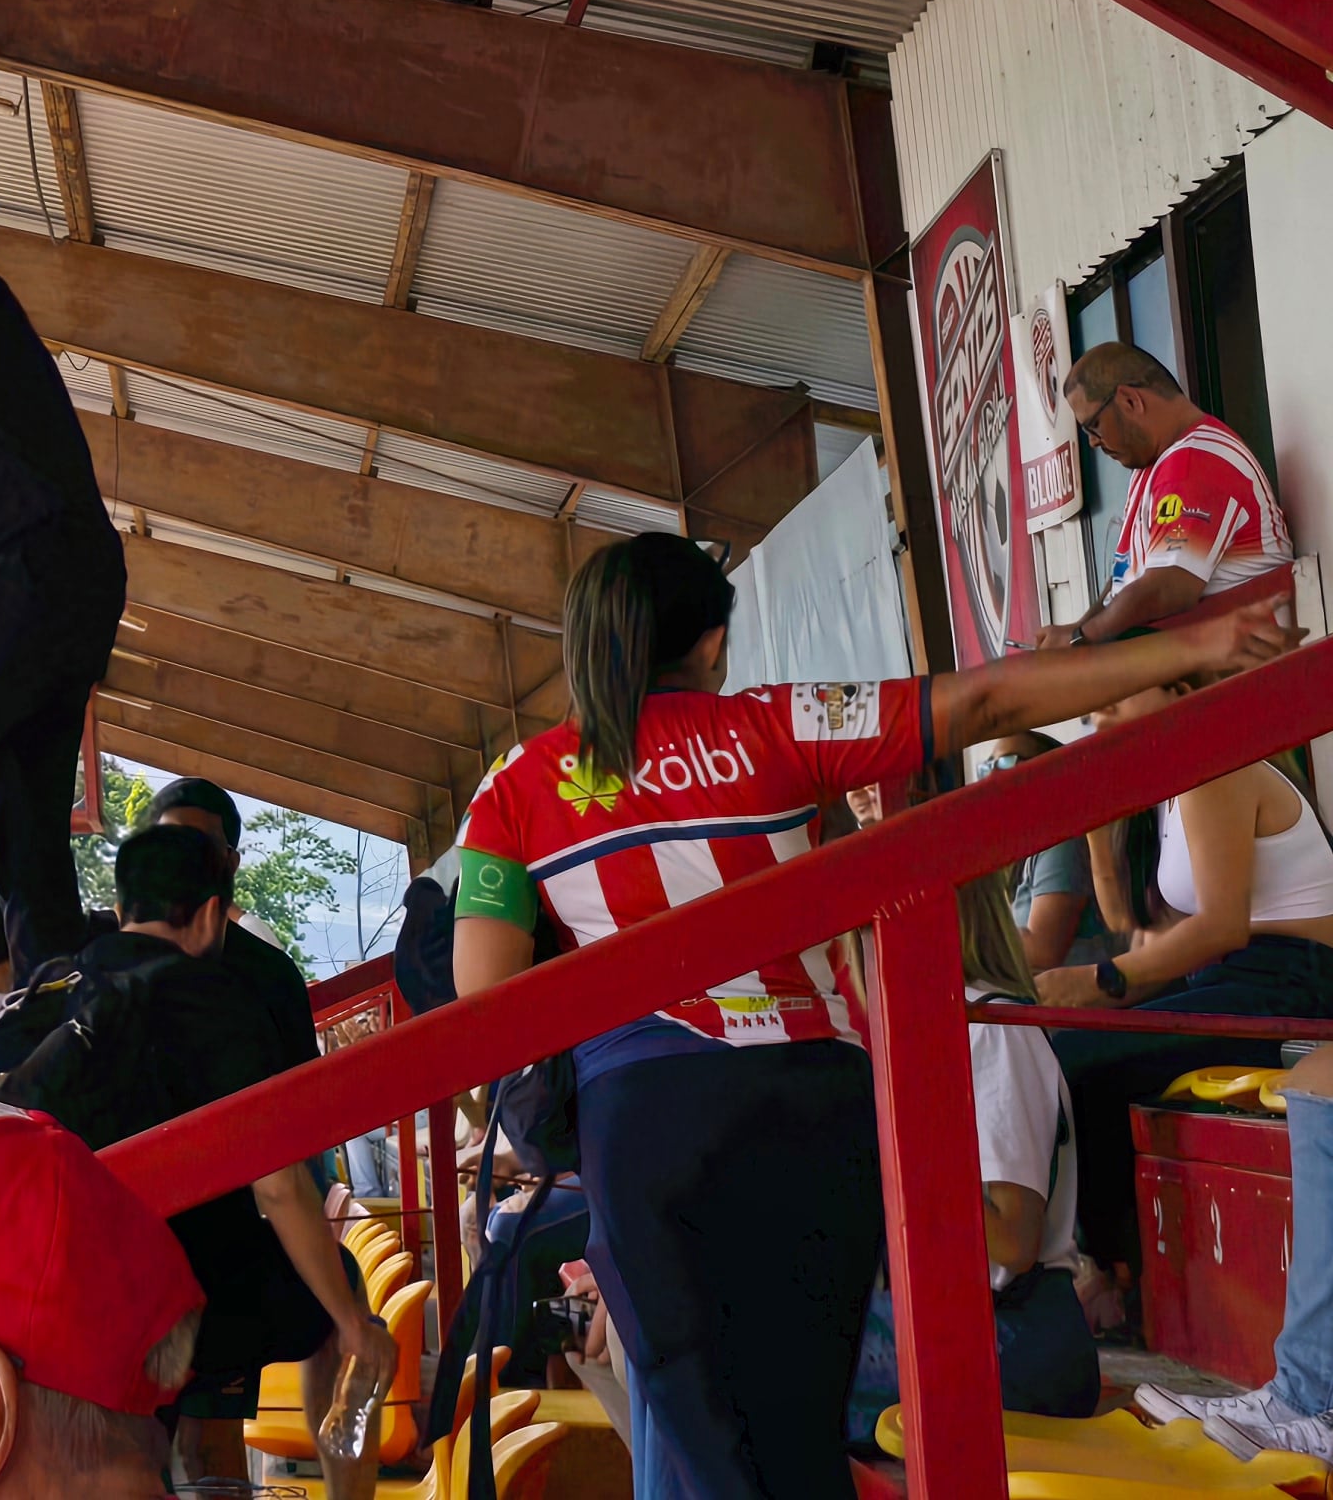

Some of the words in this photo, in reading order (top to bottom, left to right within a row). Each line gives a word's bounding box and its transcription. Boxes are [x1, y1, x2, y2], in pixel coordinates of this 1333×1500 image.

[942, 257, 997, 475] SANTOS
[1027, 448, 1073, 510] BLOQUE
[629, 729, 755, 795] kölbi
